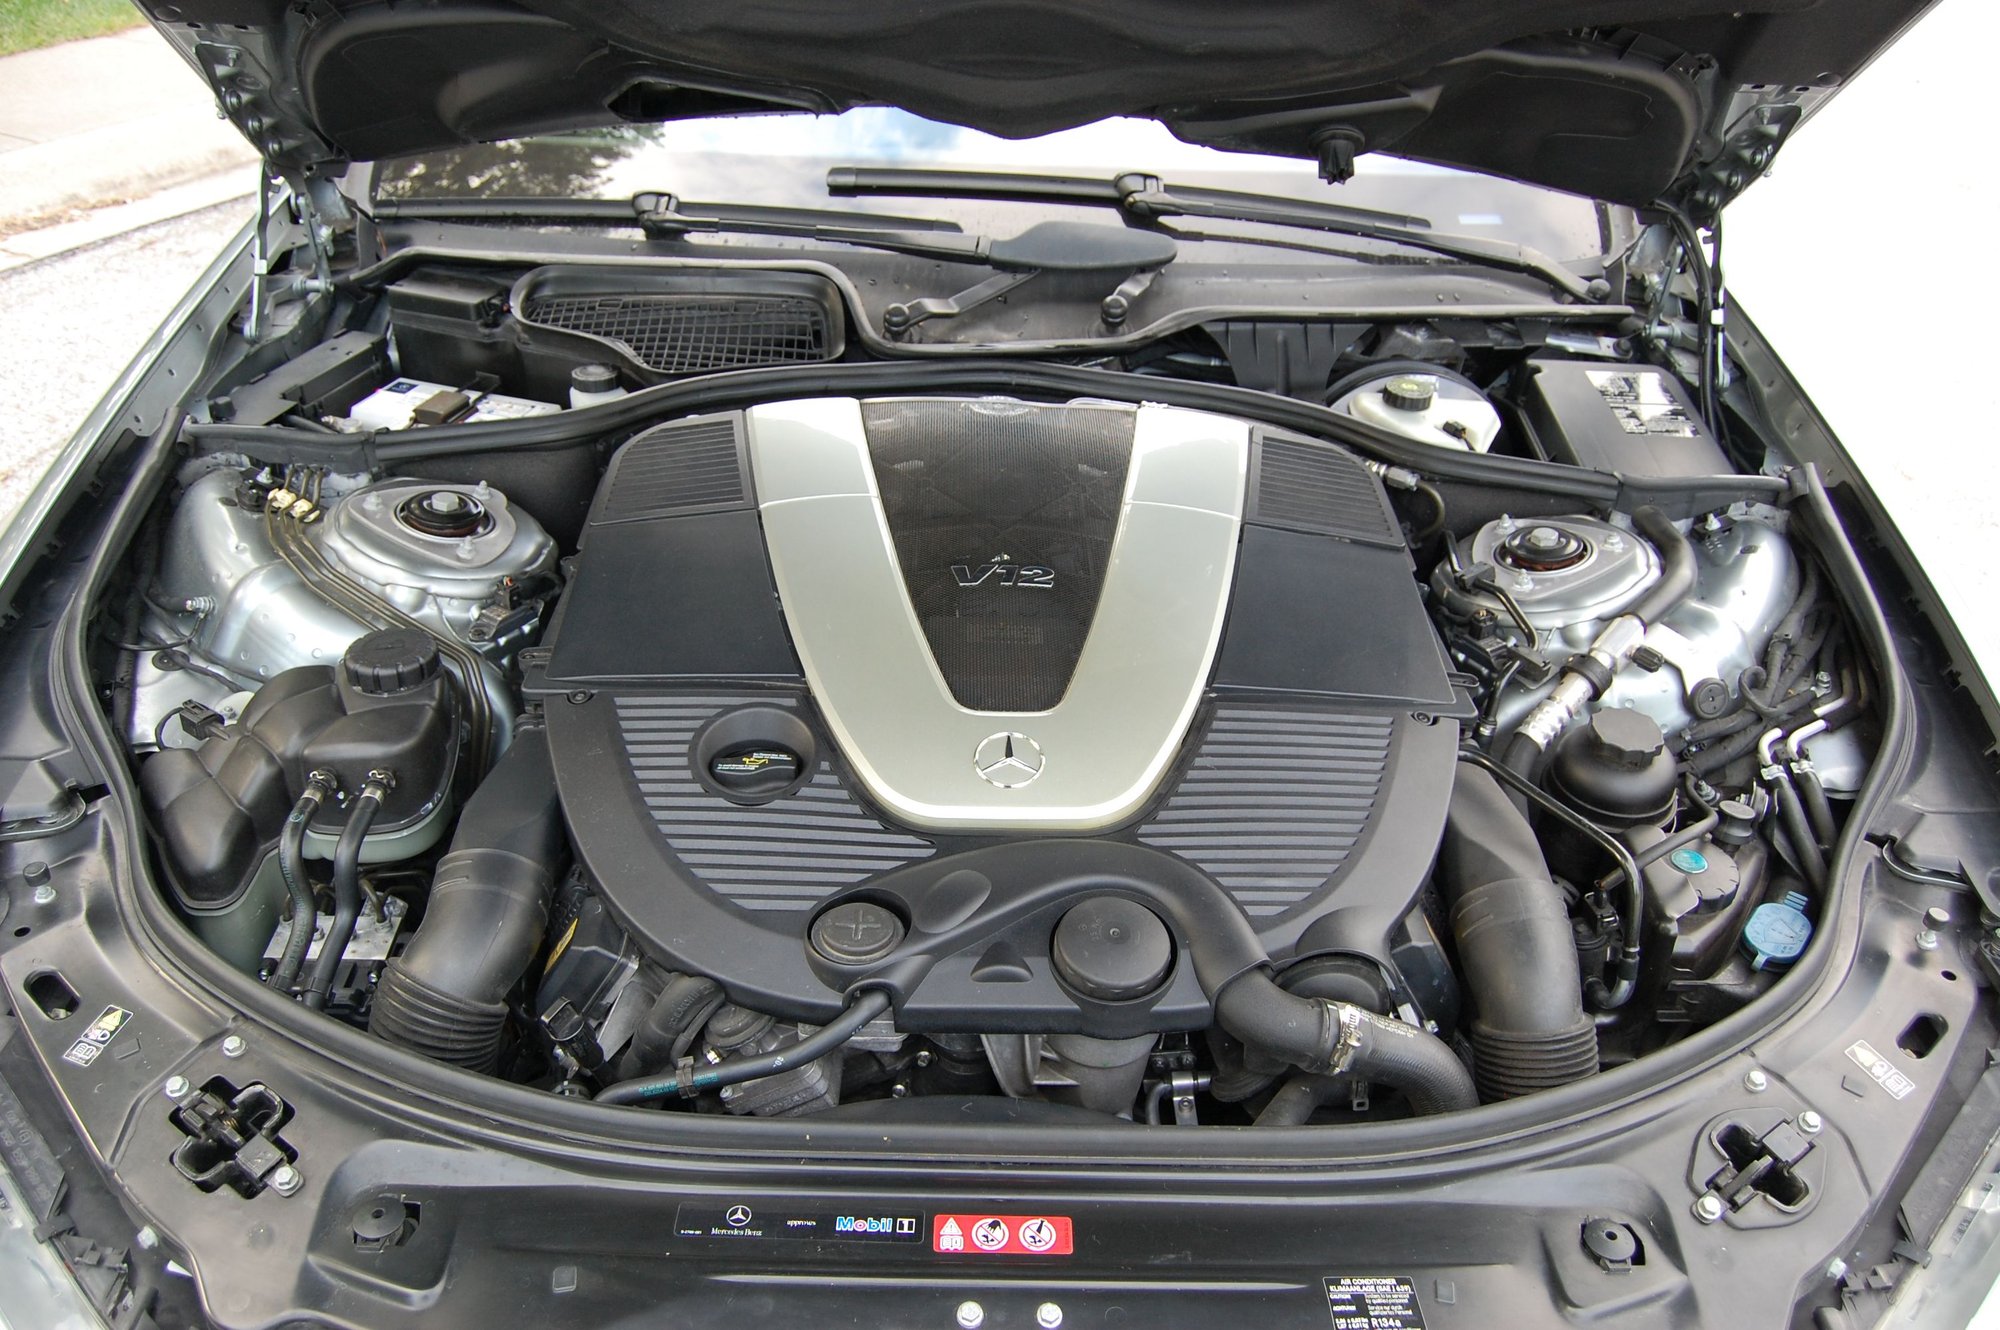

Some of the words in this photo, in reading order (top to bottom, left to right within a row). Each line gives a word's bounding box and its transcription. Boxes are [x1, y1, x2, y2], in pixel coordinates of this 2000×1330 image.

[951, 565, 1055, 588] V12
[836, 1216, 893, 1233] Mobil
[1352, 1278, 1397, 1286] CONDITIONER
[1370, 1317, 1402, 1328] R134a
